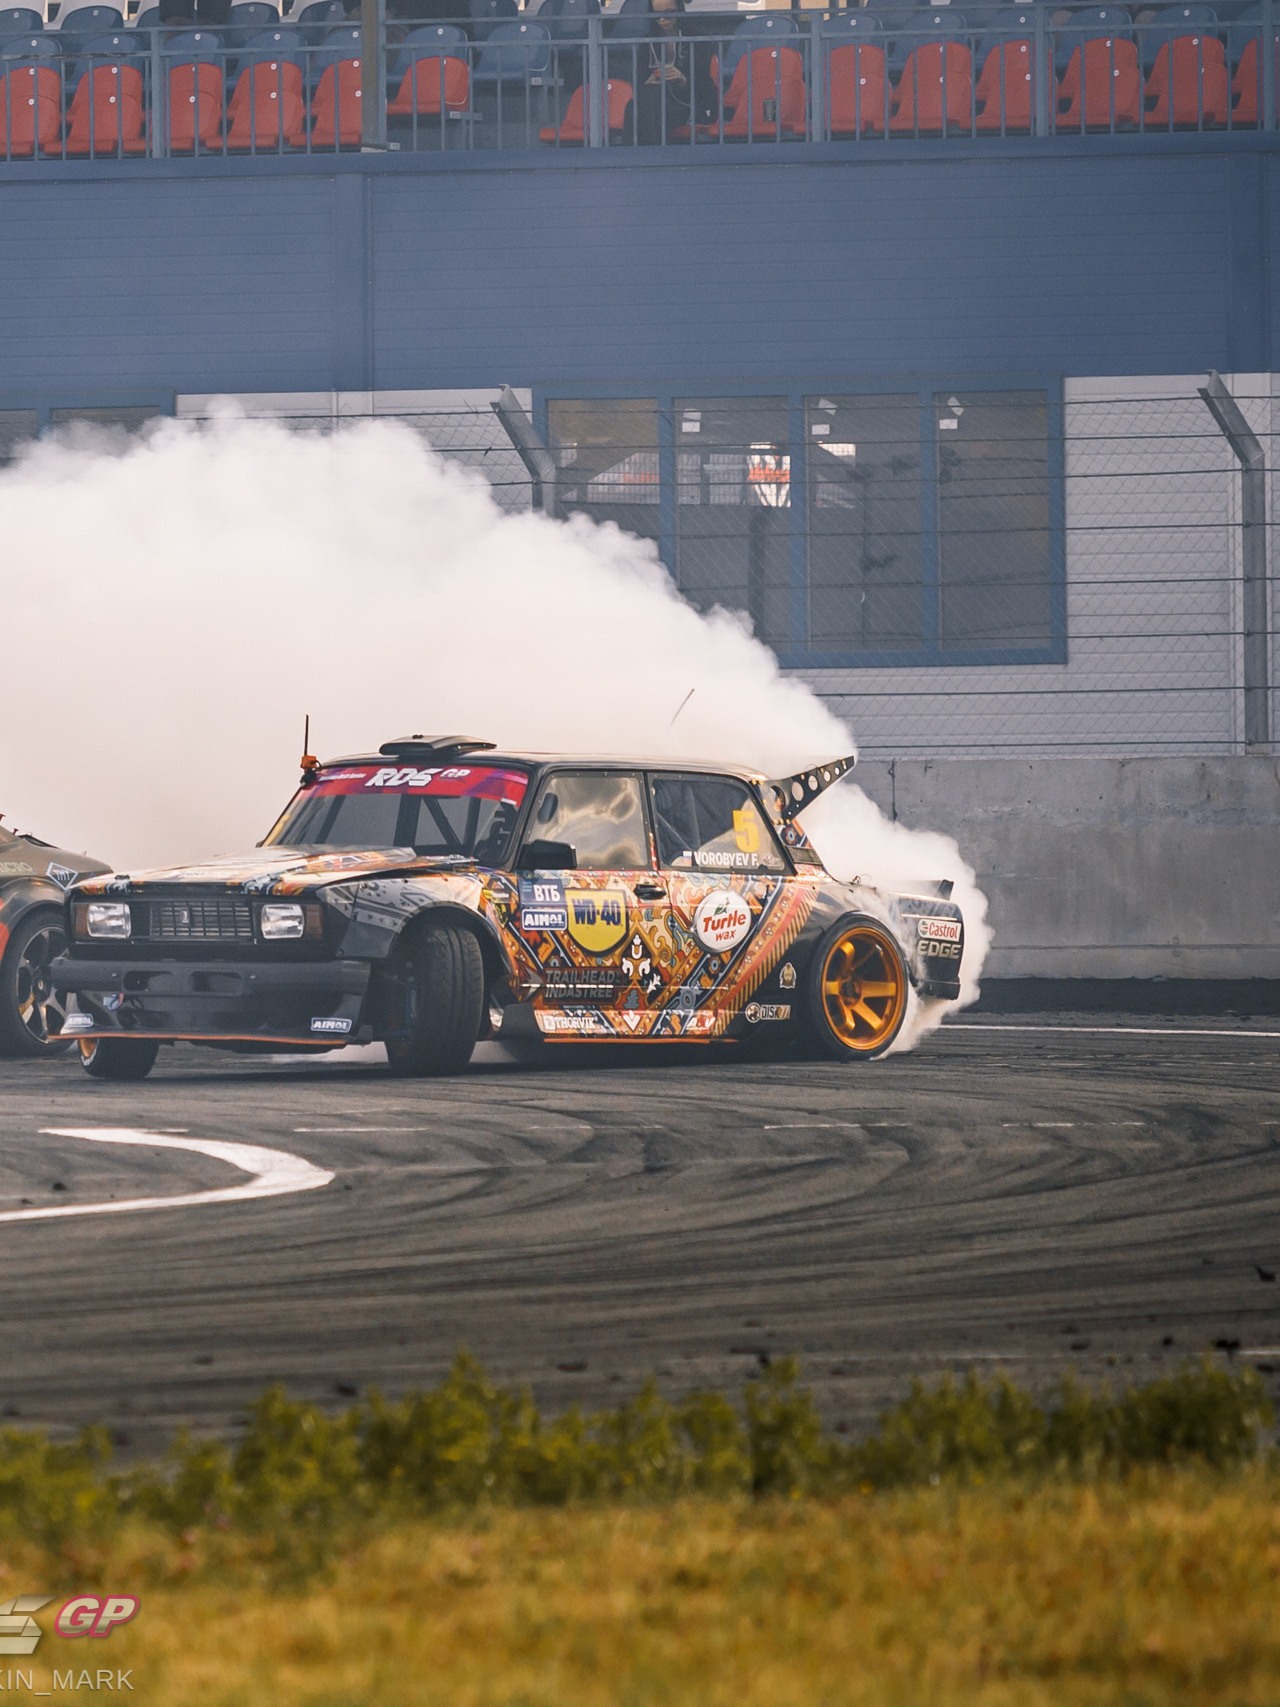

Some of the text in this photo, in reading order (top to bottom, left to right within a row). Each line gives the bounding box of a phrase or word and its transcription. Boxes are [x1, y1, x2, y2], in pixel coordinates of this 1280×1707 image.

[365, 768, 444, 787] RDS
[732, 810, 760, 853] 5
[694, 851, 760, 866] VOROBYEV F.
[533, 884, 561, 902] ВТБ
[524, 913, 565, 927] AIMOL
[571, 898, 622, 926] WD-40
[703, 910, 747, 933] Turtle
[715, 930, 736, 942] wax
[928, 922, 959, 939] Castrol
[917, 940, 961, 960] EDGE
[545, 970, 615, 984] TRAILHEAD
[545, 984, 614, 998] INDASTREE
[313, 1020, 348, 1030] AIMOL
[554, 1015, 597, 1029] THORVIK
